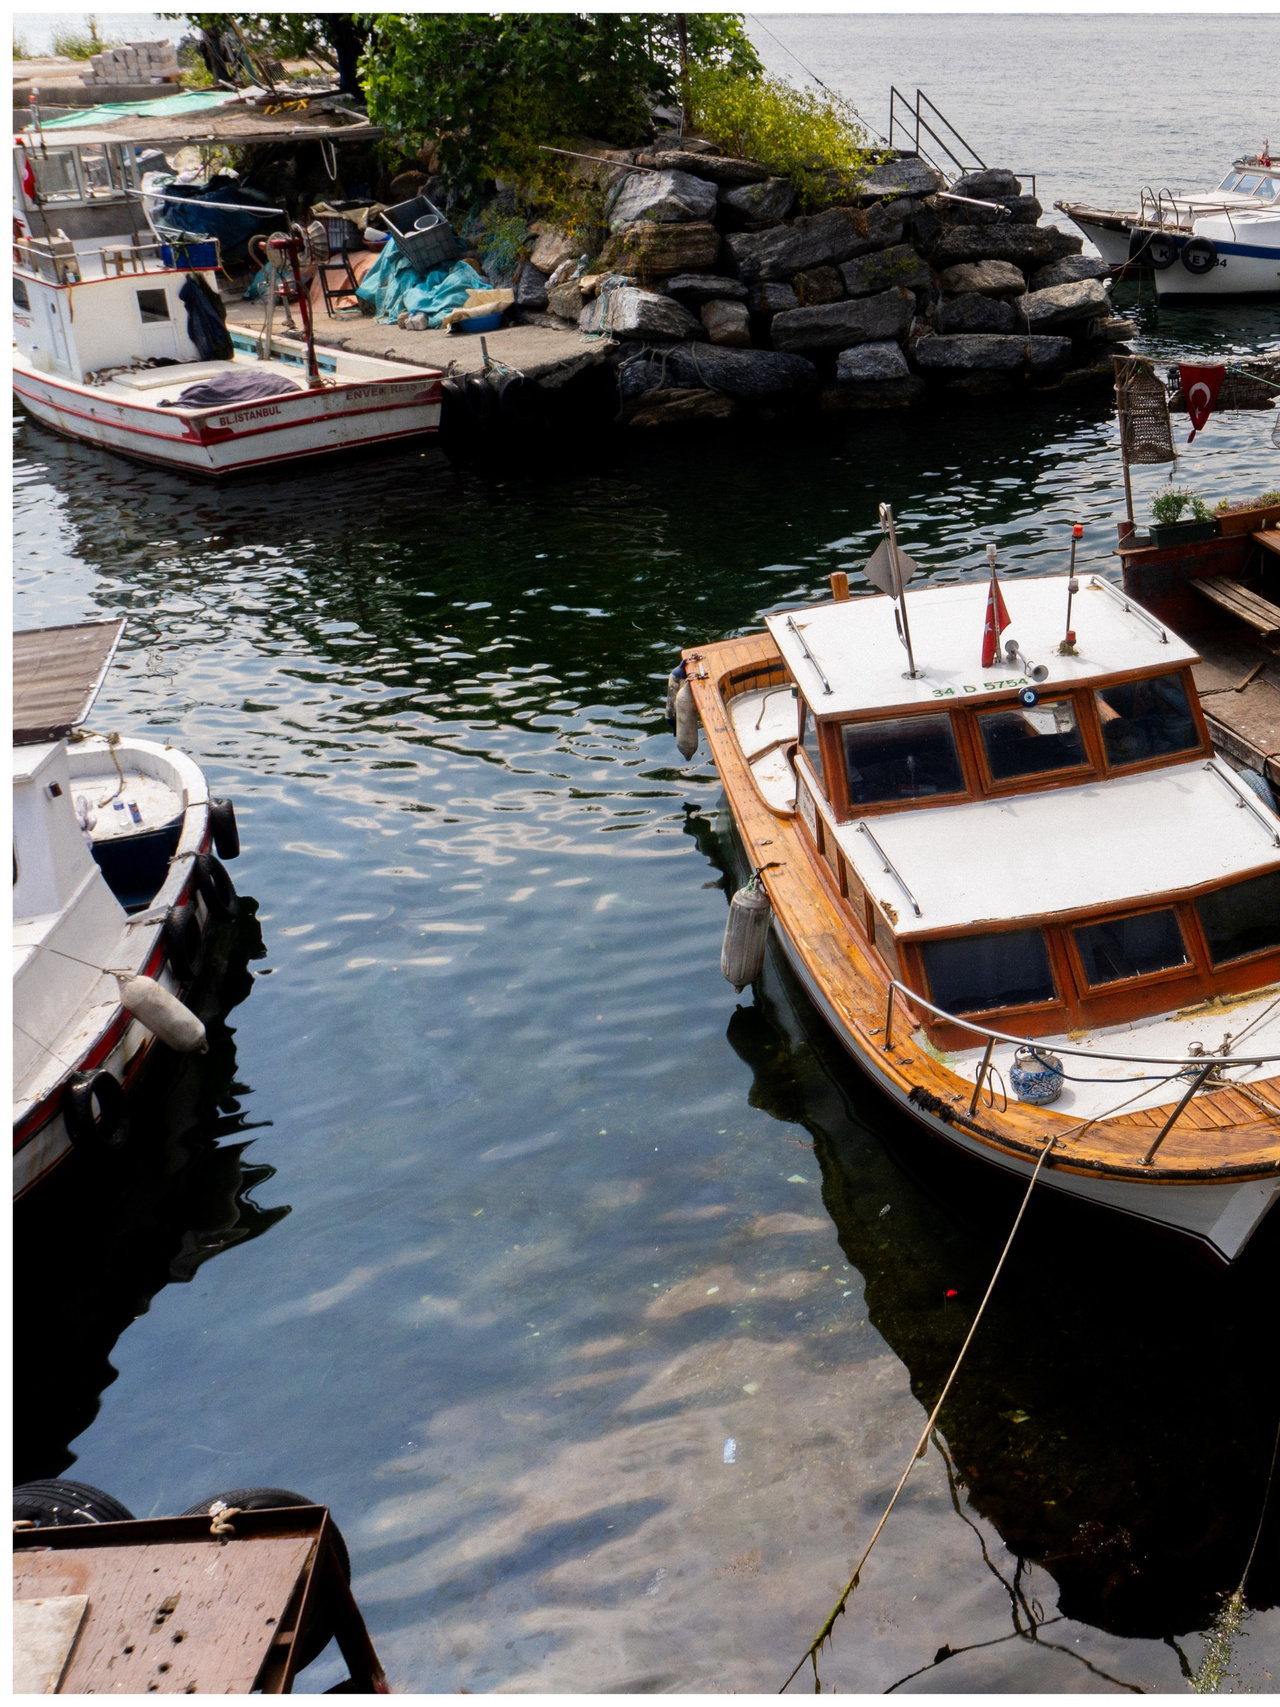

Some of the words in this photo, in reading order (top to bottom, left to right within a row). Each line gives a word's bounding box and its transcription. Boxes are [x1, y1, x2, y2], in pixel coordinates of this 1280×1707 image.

[219, 405, 282, 426] BL.İSTANBUL
[932, 687, 955, 698] 34
[963, 685, 977, 693] D
[983, 678, 1029, 691] 5754
